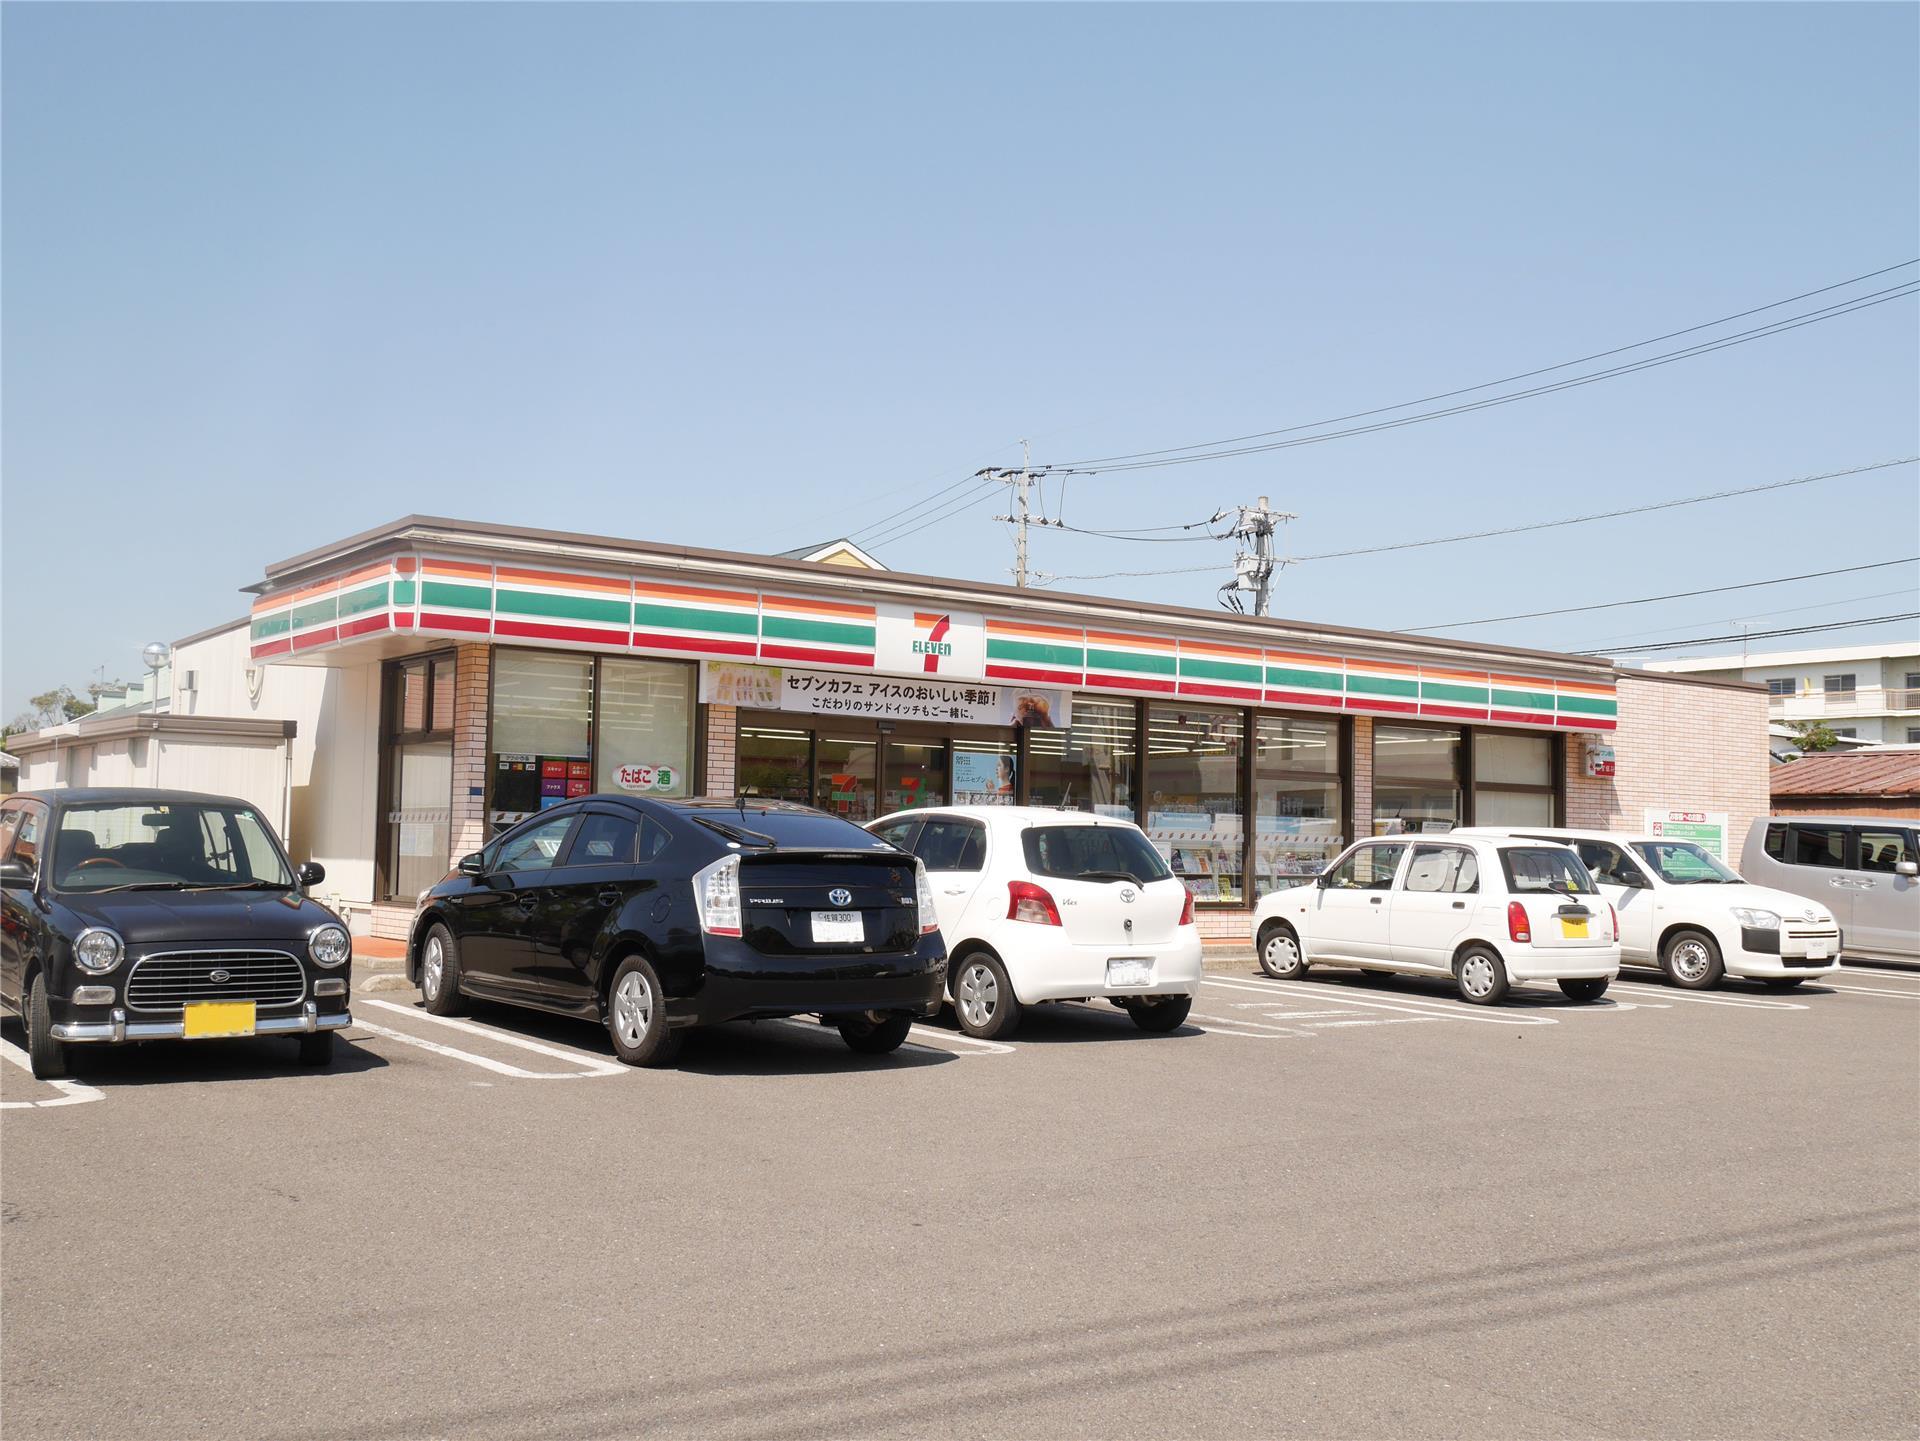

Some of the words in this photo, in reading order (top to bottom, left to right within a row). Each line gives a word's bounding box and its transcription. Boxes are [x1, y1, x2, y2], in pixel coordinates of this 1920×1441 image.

[787, 675, 863, 694] セブンカフェ
[811, 696, 975, 720] こだわりのサンドイッチもご一緒に。
[620, 768, 652, 784] たばこ
[657, 769, 671, 785] 酒
[838, 913, 852, 922] 300
